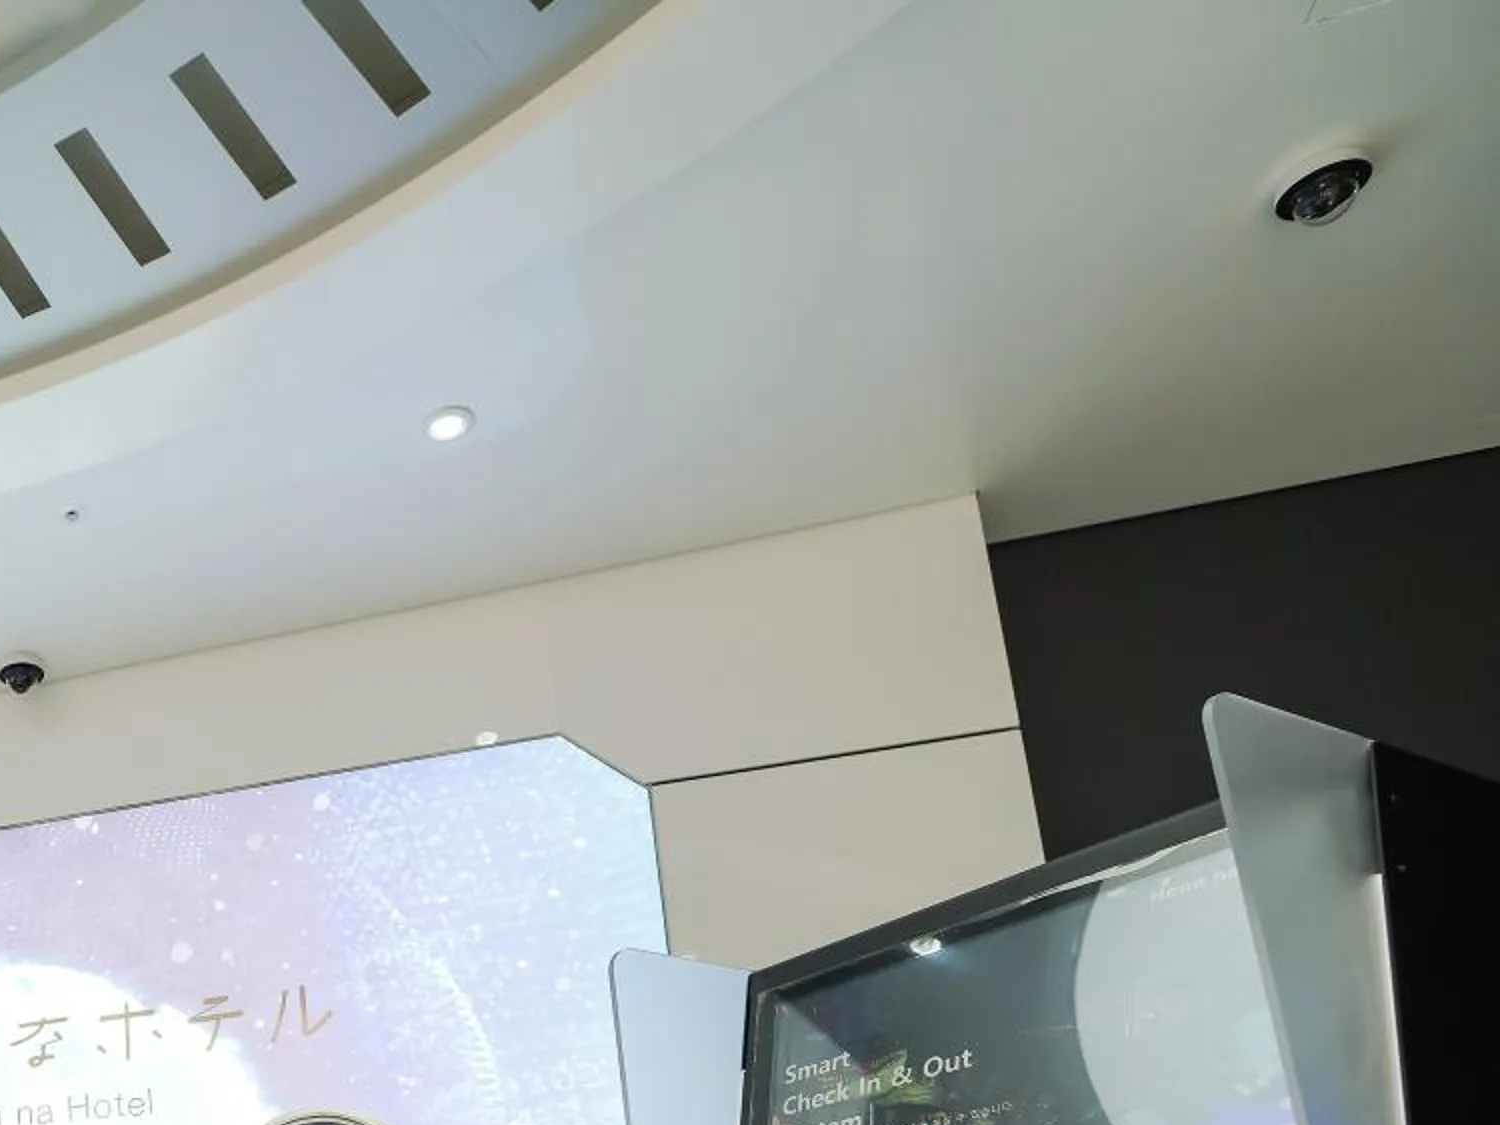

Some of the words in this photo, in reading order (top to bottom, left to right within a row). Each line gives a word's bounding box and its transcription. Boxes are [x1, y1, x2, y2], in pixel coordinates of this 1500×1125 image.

[783, 1081, 849, 1115] Check
[860, 1075, 881, 1096] In
[892, 1066, 912, 1087] &
[923, 1049, 973, 1077] Out
[785, 1051, 851, 1085] Smart
[68, 1088, 153, 1121] Hotel
